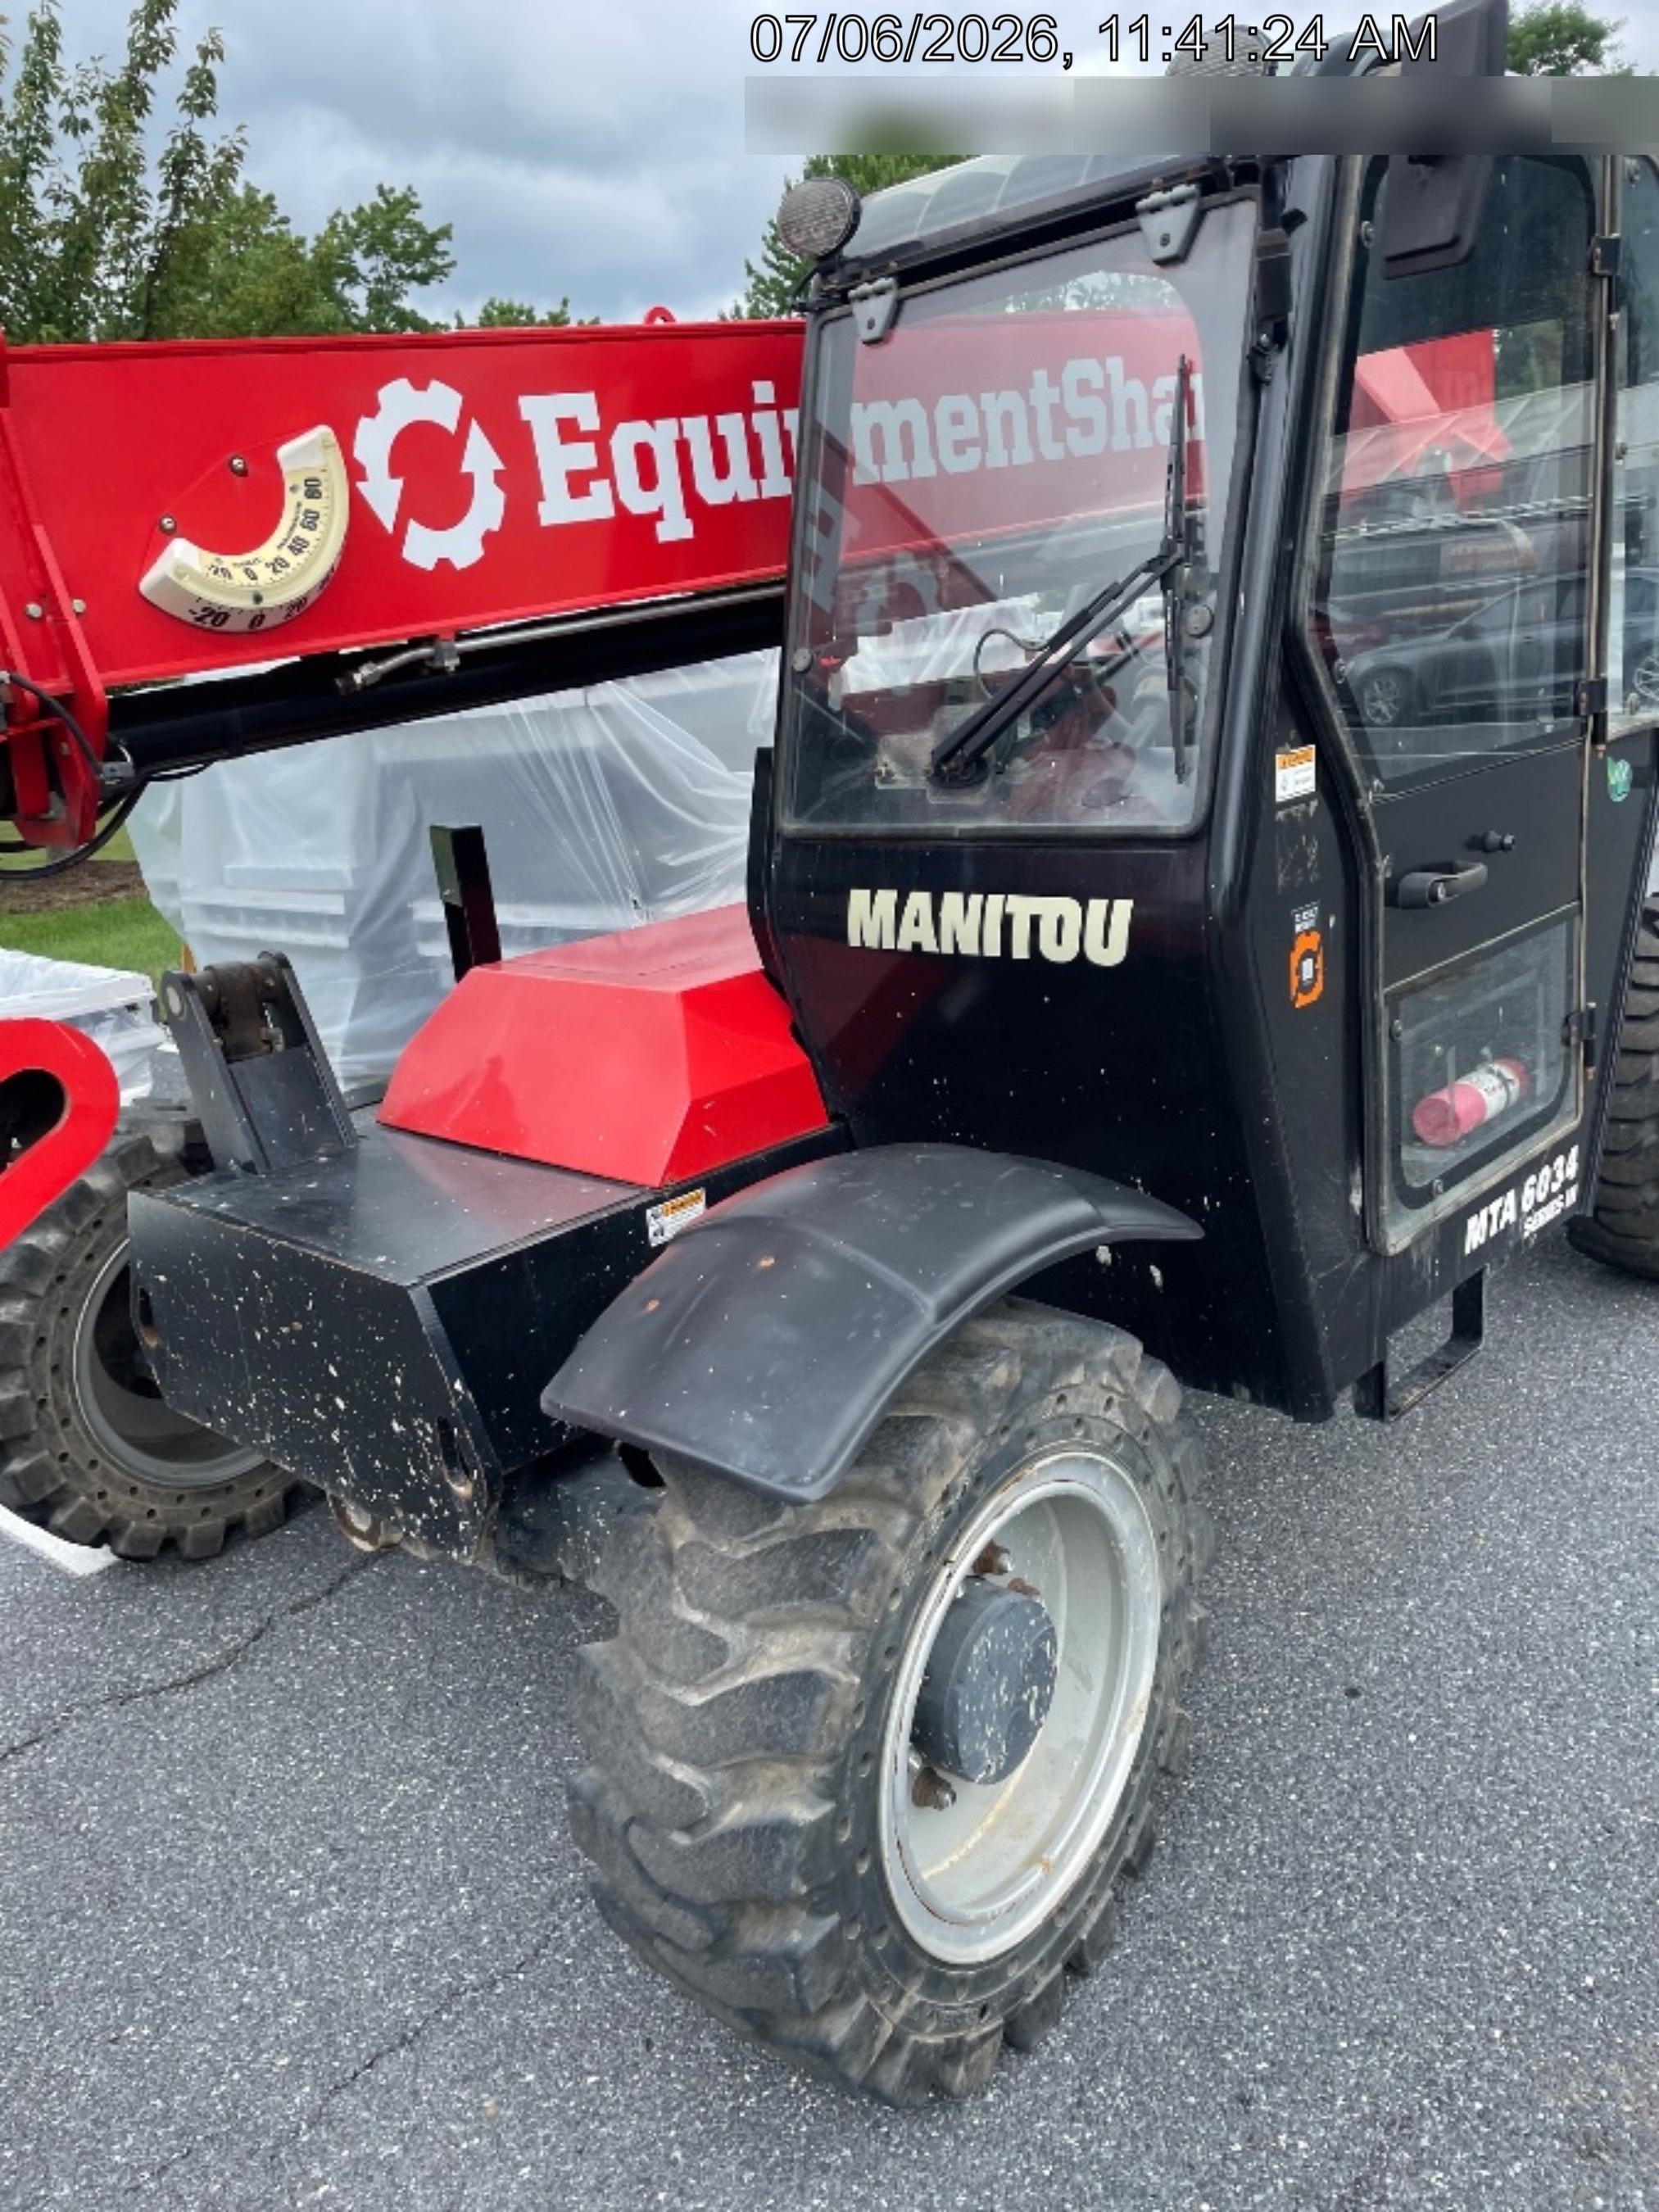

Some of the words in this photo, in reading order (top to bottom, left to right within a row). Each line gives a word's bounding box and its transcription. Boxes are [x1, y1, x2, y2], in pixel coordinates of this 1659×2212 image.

[265, 556, 290, 574] 20
[188, 606, 231, 628] -20
[247, 613, 266, 630] 0
[847, 888, 1135, 968] MANITOU
[1465, 1188, 1516, 1255] MTA
[1521, 1144, 1579, 1213] 6034
